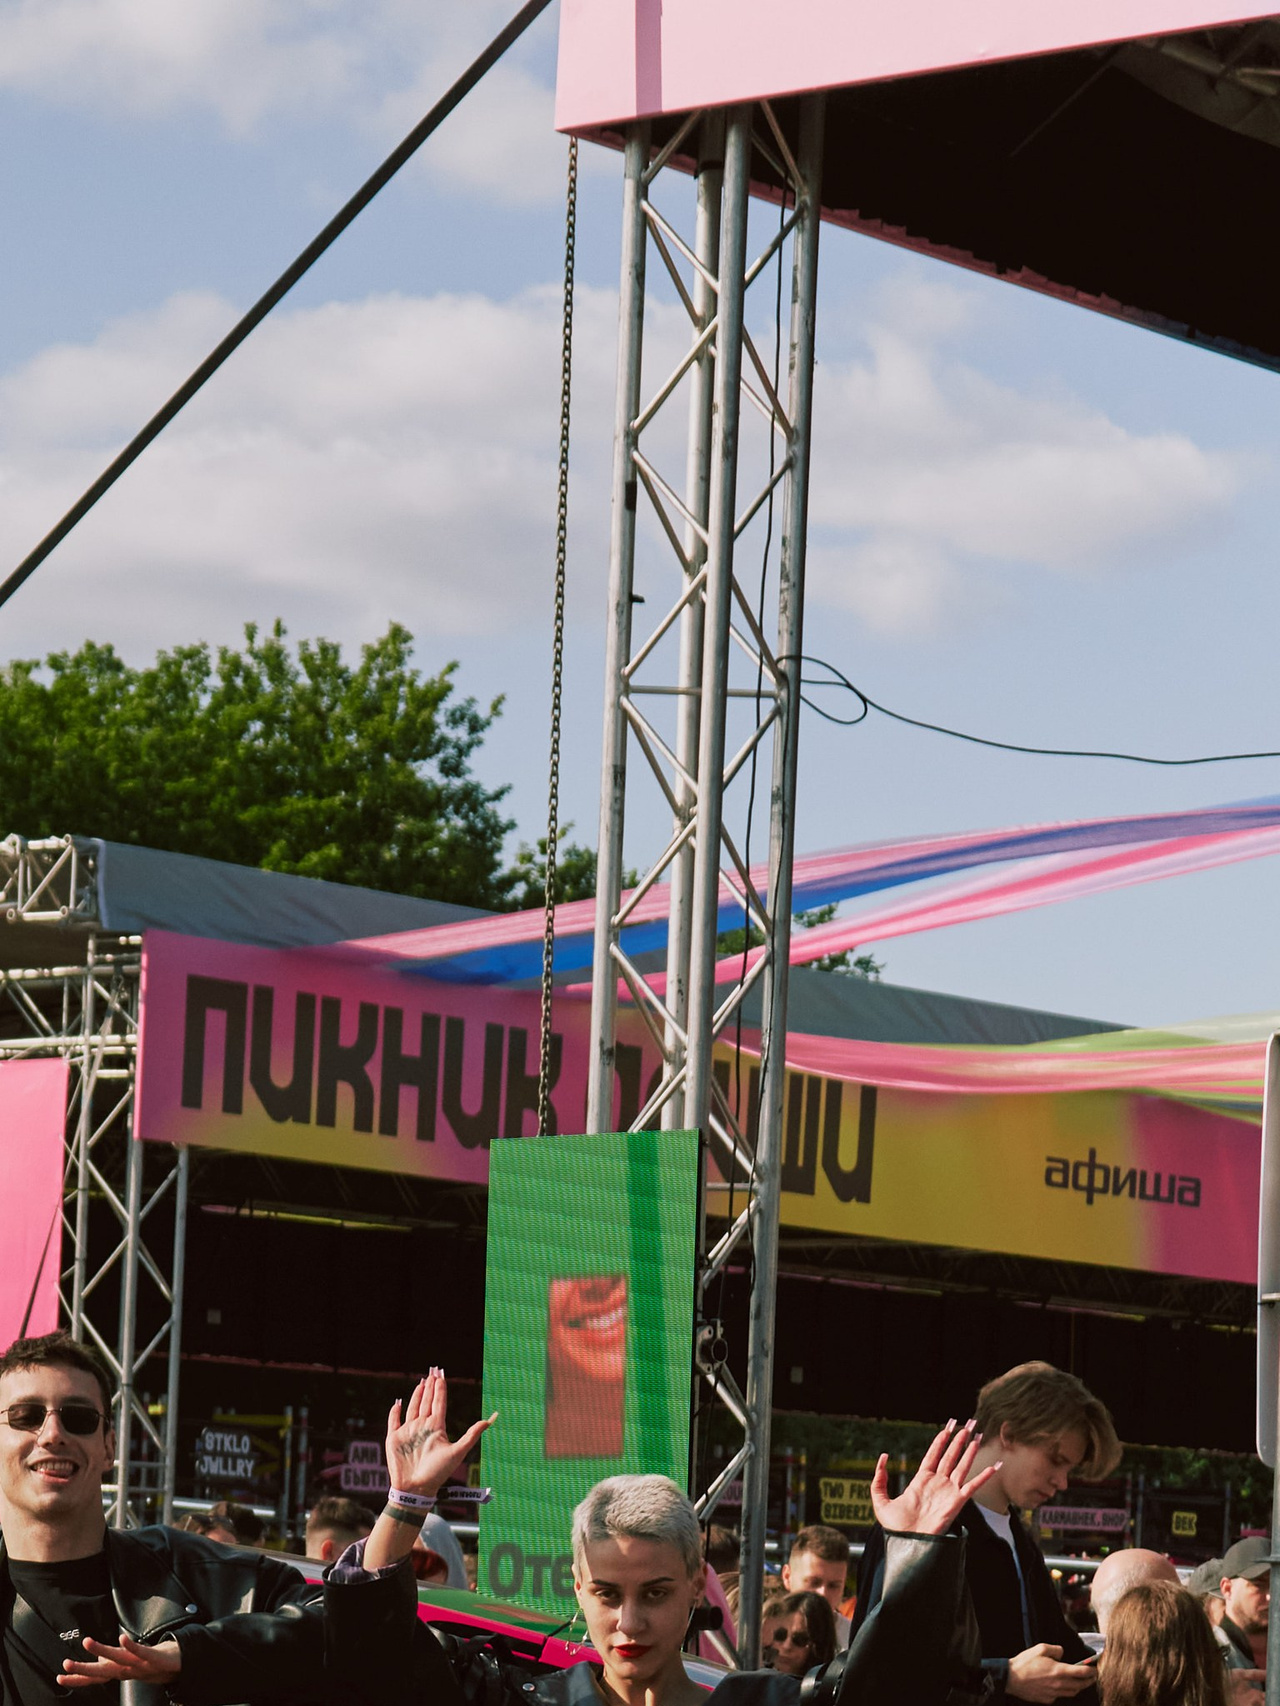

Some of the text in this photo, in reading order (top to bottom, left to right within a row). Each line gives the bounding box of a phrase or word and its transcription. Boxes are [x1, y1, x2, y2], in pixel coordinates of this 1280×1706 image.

[181, 973, 879, 1205] ПИКНИК ИШИ
[1045, 1147, 1202, 1208] афиша
[200, 1455, 255, 1478] JWLLRY
[823, 1481, 871, 1500] TWO FRO
[488, 1541, 574, 1598] Оте
